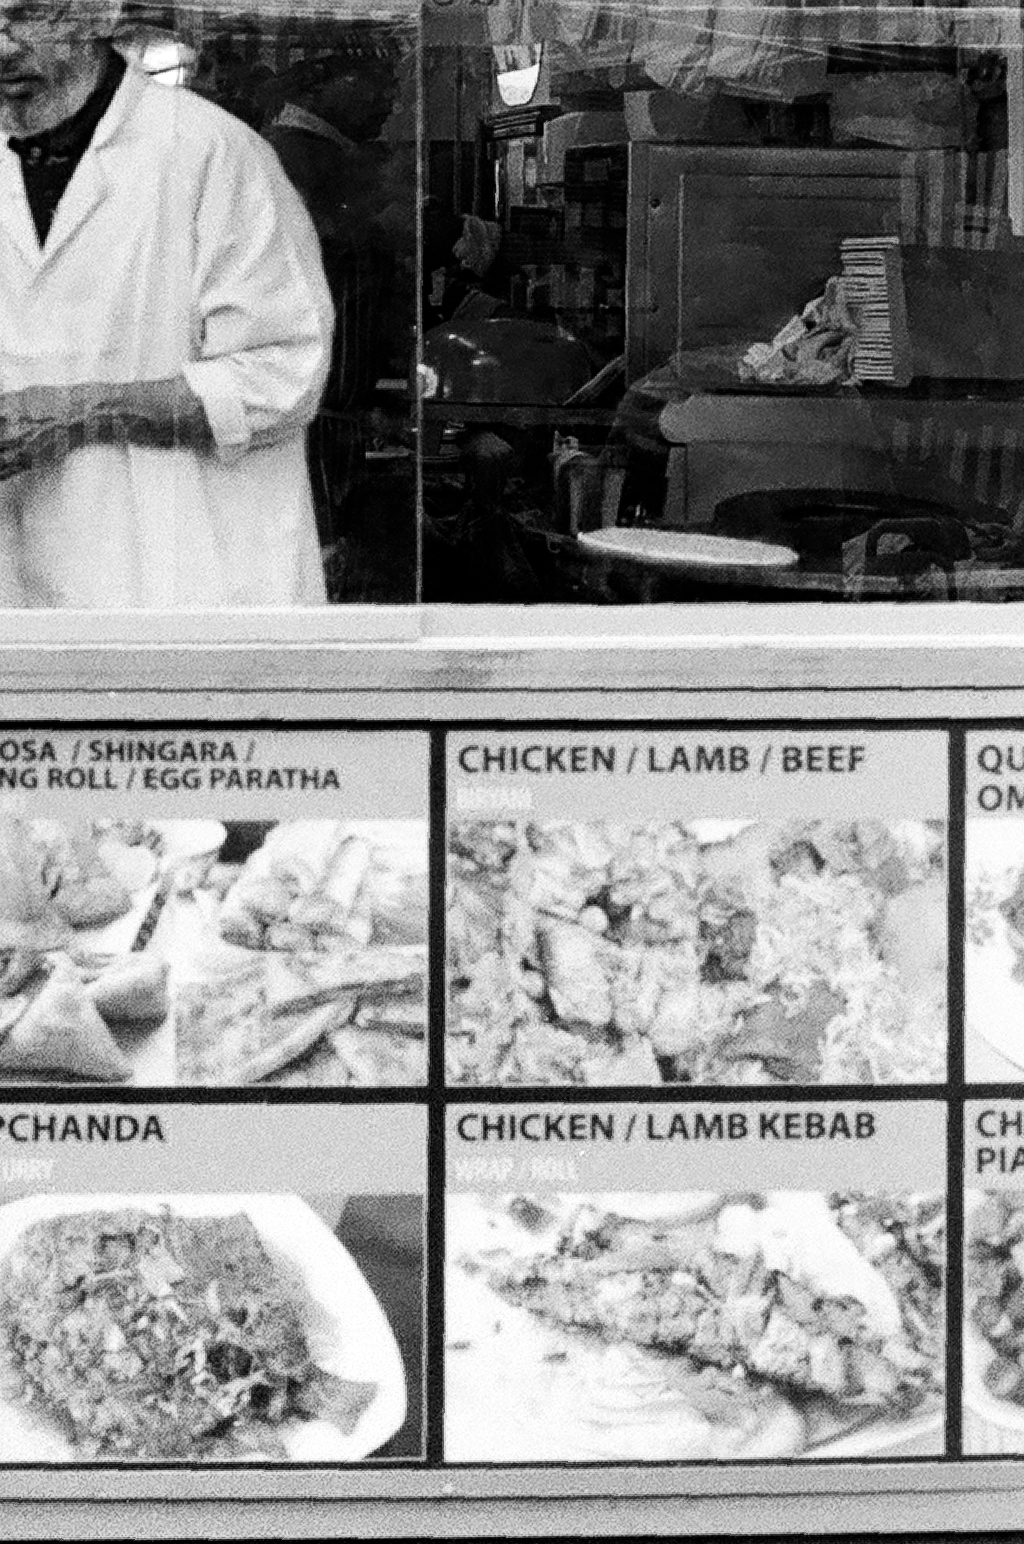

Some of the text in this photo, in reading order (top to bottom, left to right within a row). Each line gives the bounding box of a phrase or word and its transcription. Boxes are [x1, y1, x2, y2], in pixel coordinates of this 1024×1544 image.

[90, 740, 238, 762] SHINGARA
[458, 745, 616, 773] CHICKEN
[648, 745, 749, 773] LAMB
[782, 744, 865, 772] BEEF
[49, 767, 116, 790] ROLL
[144, 767, 201, 791] EGG
[210, 767, 341, 791] PARATHA
[457, 1112, 615, 1141] CHICKEN
[647, 1112, 748, 1140] LAMB
[759, 1111, 876, 1140] KEBAB
[977, 1109, 1023, 1138] CH
